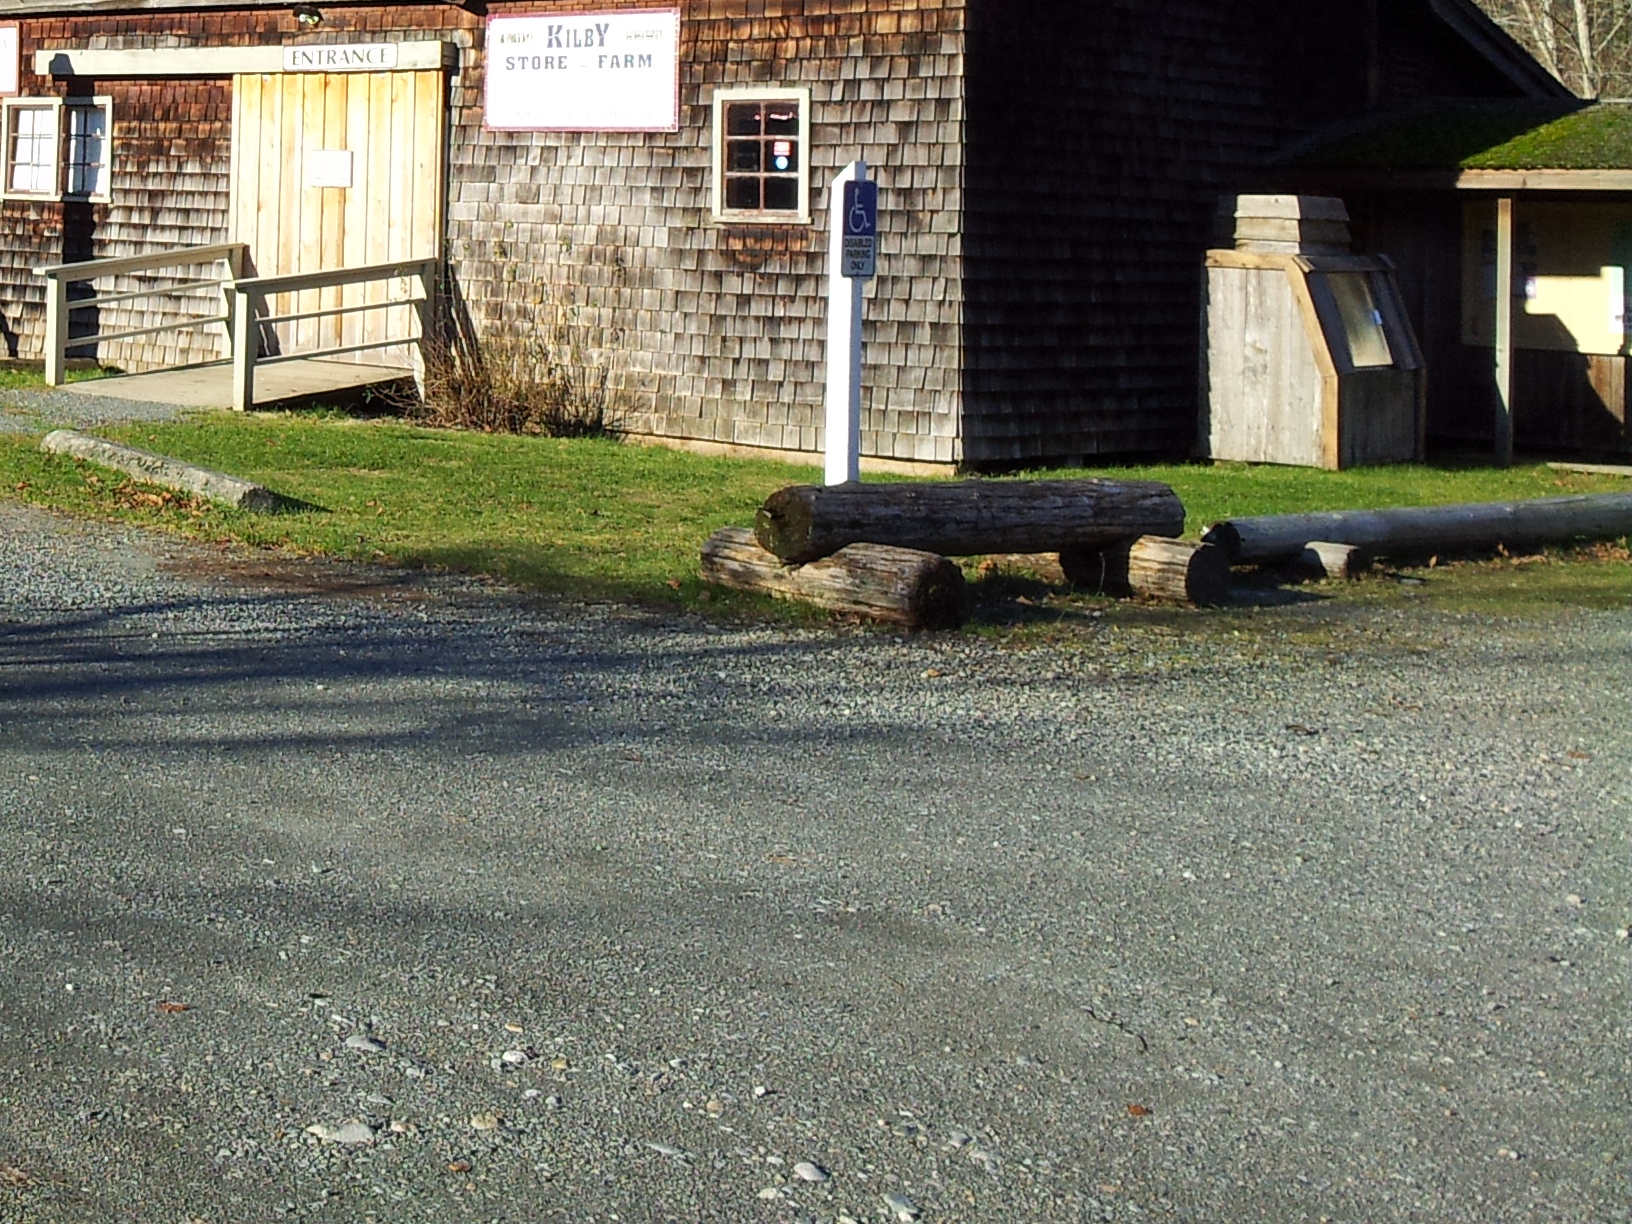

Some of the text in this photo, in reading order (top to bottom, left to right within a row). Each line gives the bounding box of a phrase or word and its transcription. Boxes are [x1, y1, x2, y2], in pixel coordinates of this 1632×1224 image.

[546, 22, 610, 49] KILBY
[292, 47, 388, 66] ENTRANCE
[505, 53, 653, 70] STORE FARM
